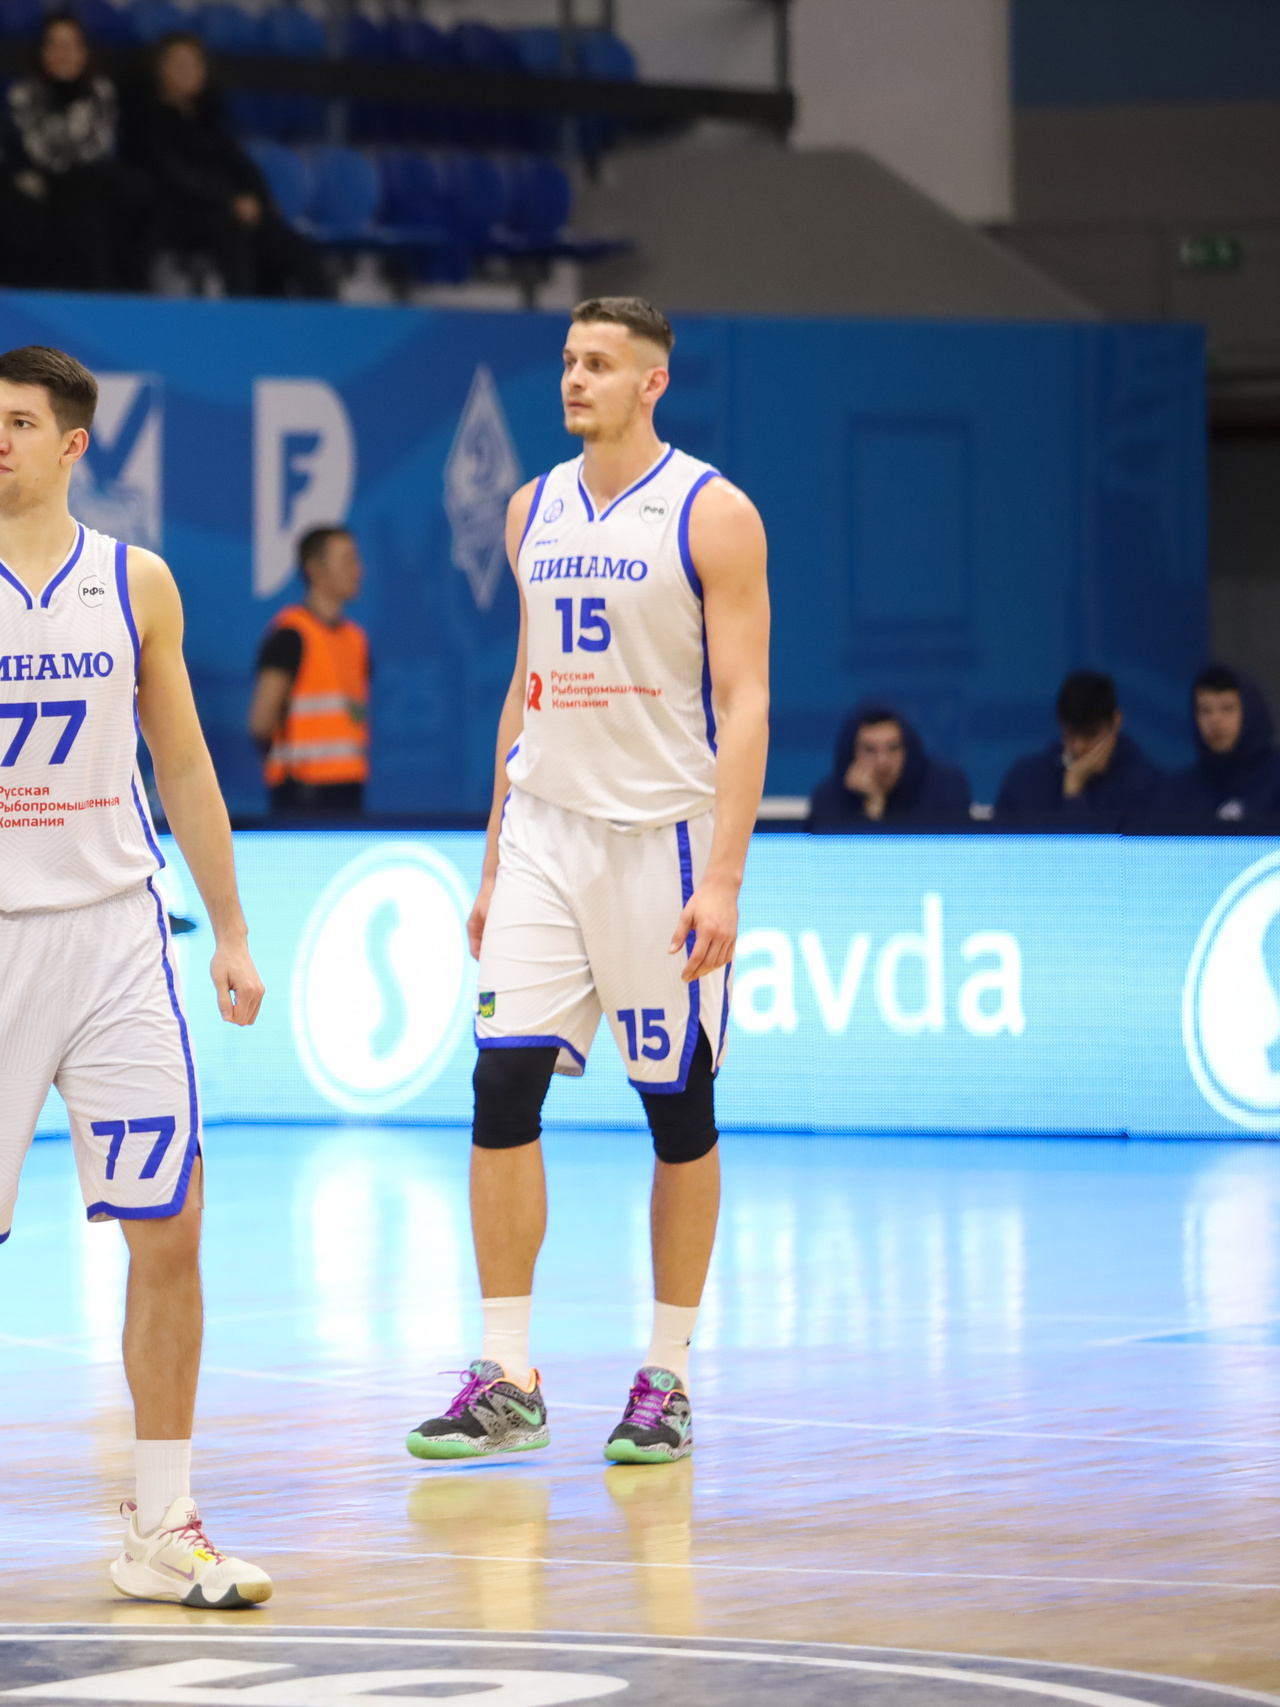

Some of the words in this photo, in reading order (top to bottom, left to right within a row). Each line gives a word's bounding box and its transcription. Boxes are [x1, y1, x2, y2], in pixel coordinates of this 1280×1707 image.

[530, 556, 648, 583] ДИНАМО
[555, 598, 611, 653] 15
[551, 670, 595, 682] Русская
[730, 893, 1027, 1037] avda
[617, 1008, 670, 1061] 15
[91, 1115, 176, 1180] 77
